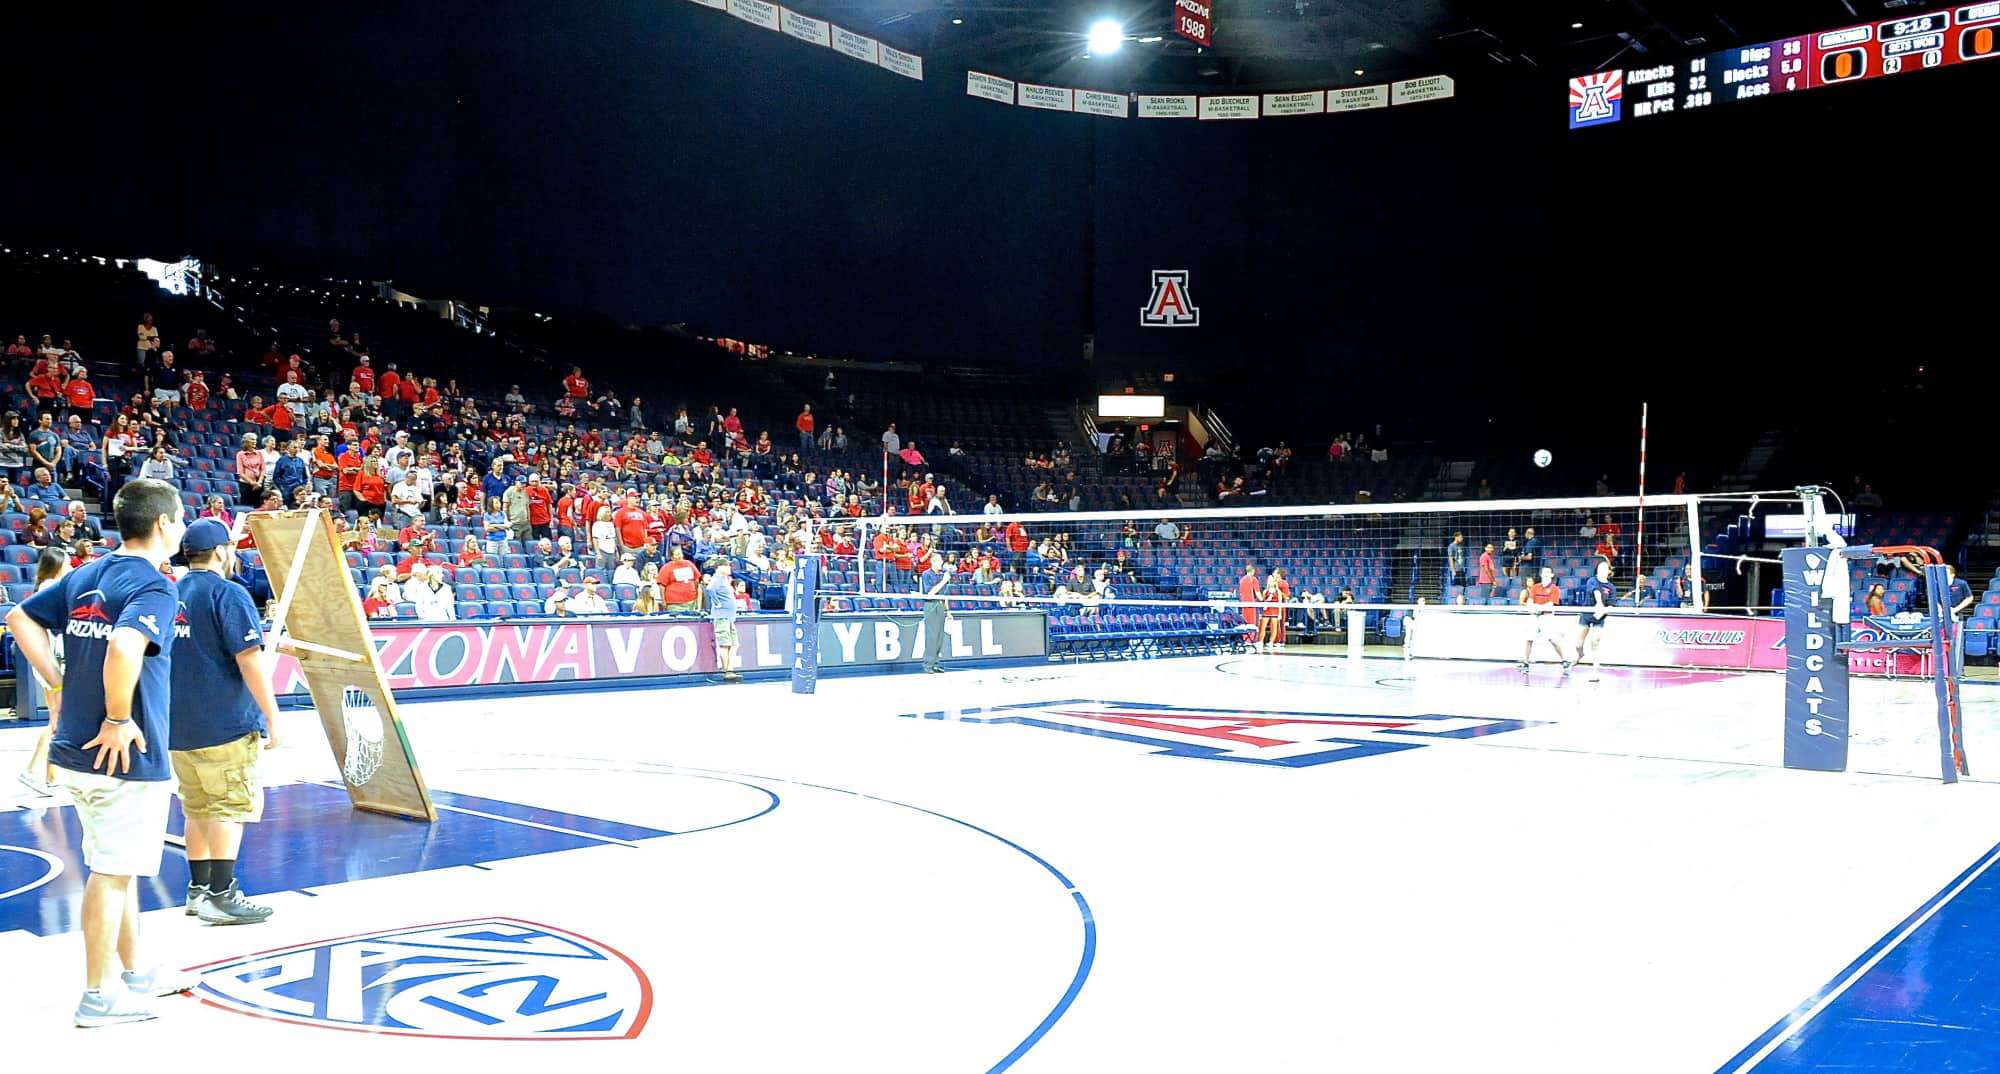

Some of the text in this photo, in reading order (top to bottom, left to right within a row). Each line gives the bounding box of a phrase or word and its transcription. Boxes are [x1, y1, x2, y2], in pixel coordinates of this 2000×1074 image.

[1181, 16, 1205, 39] 1988
[1740, 46, 1771, 64] Digs
[1404, 77, 1441, 89] BOB ELLIOTT
[1626, 65, 1675, 85] Attacks
[1689, 75, 1707, 91] 32
[1723, 65, 1769, 84] Blocks
[1044, 88, 1064, 97] REEVES
[1085, 92, 1118, 103] CHRIS MILLS
[1291, 93, 1313, 102] ELLIOTT
[1340, 88, 1375, 98] STEVE KERR
[1736, 77, 1796, 99] Aces 4
[1653, 97, 1675, 114] Pct
[1140, 269, 1200, 327] A
[794, 568, 805, 670] ARIZONA
[606, 618, 1002, 674] VOLYBLL
[1802, 570, 1825, 737] WILDCATS
[418, 963, 608, 1026] 12
